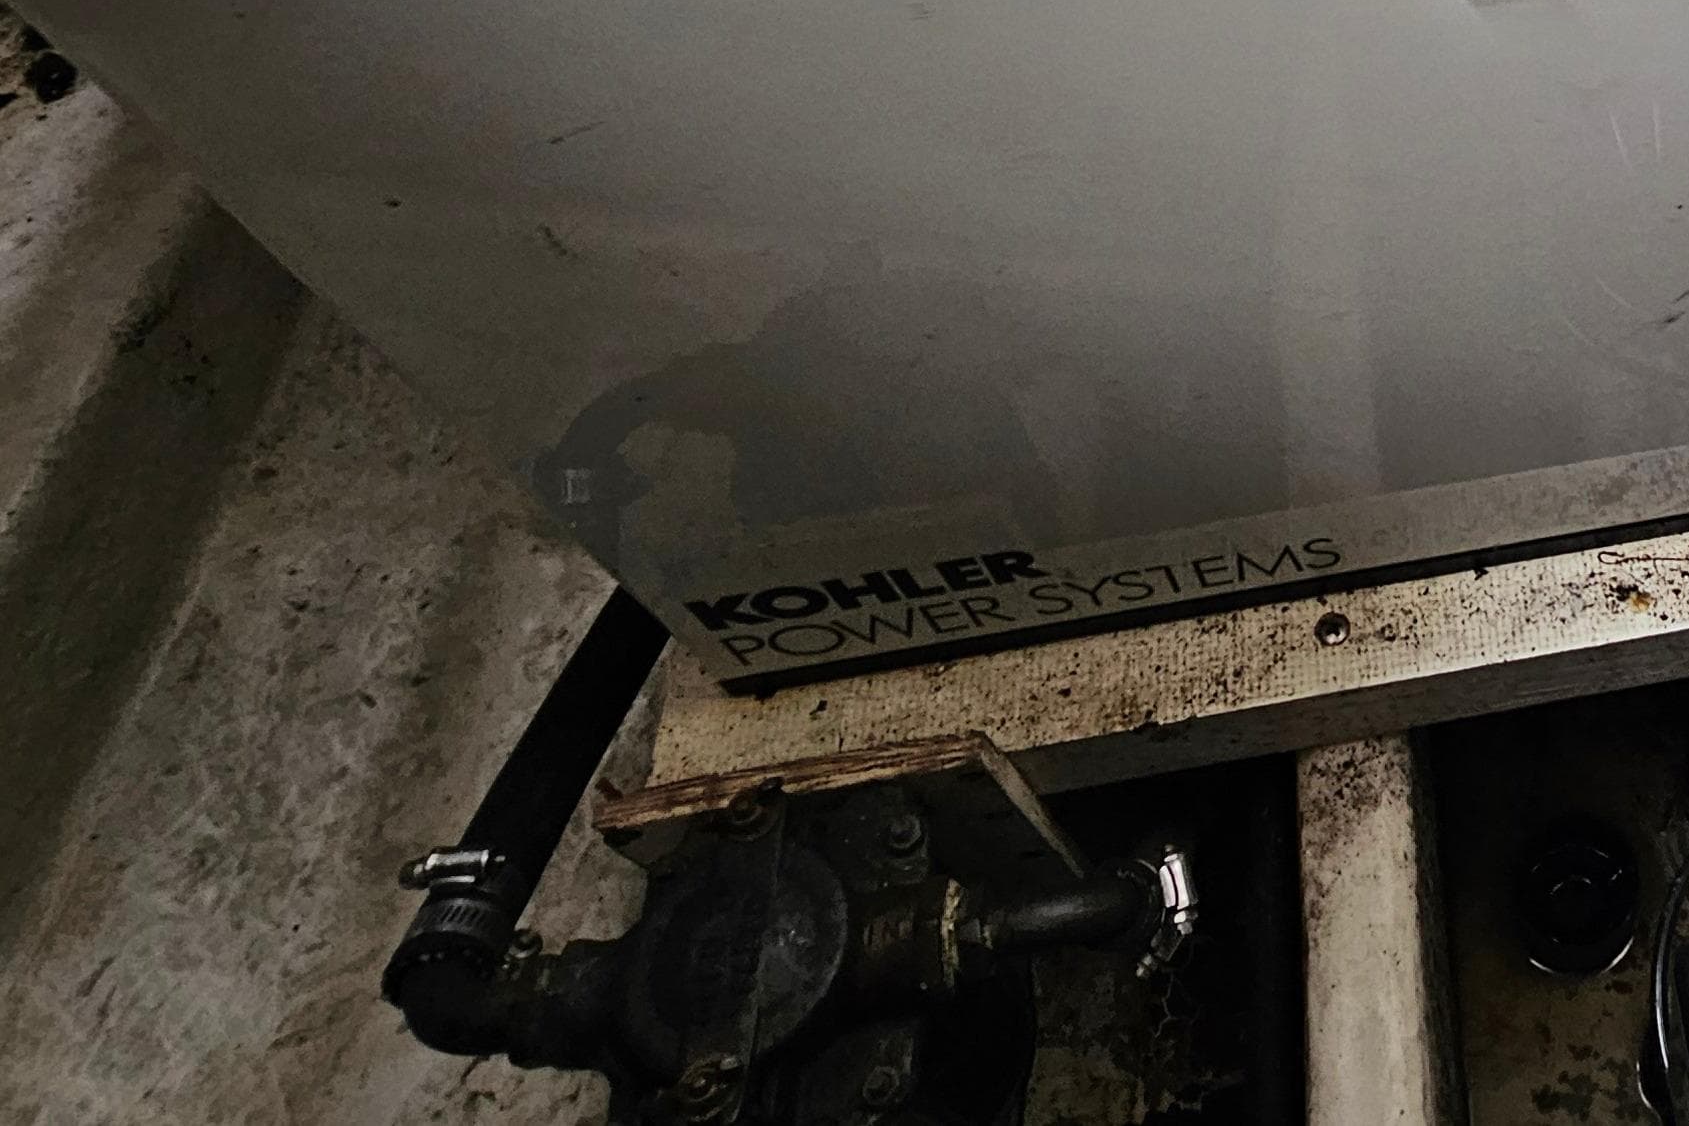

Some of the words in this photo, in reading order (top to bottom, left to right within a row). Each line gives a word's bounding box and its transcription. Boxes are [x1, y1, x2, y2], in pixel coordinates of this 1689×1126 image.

[684, 549, 1044, 633] KOHLER
[719, 595, 1016, 668] POWER
[1037, 537, 1342, 616] SYSTEMS
